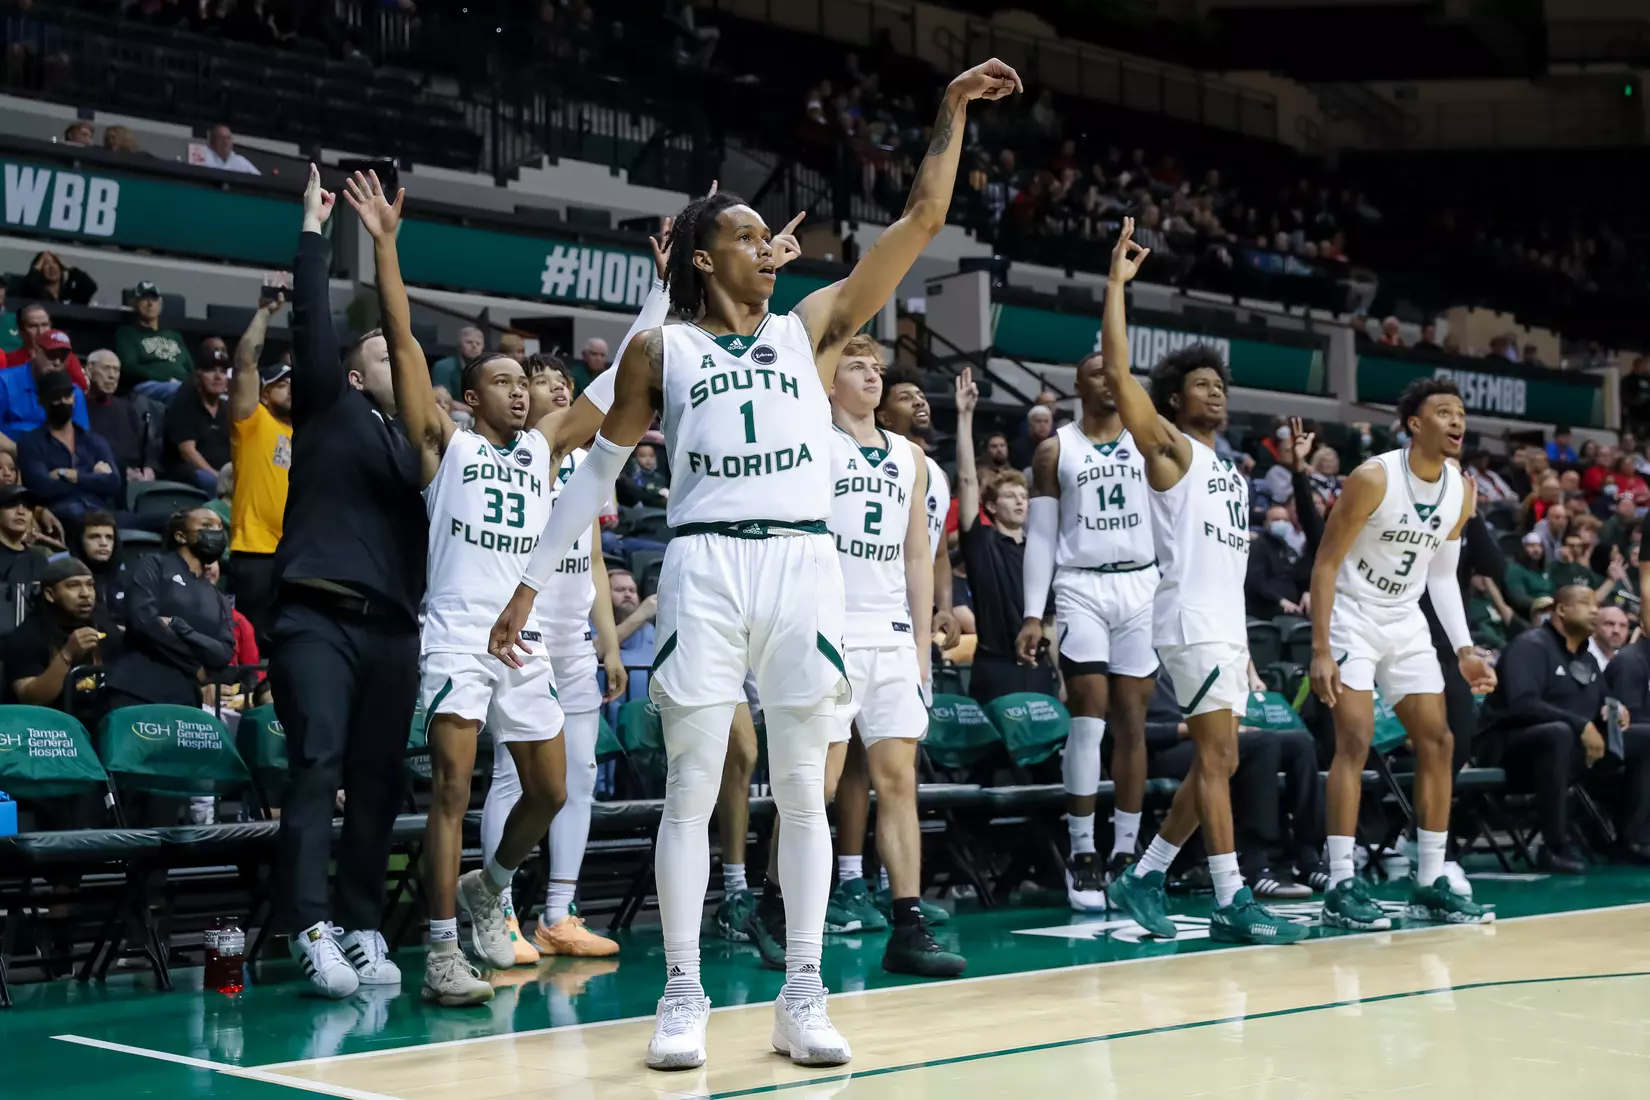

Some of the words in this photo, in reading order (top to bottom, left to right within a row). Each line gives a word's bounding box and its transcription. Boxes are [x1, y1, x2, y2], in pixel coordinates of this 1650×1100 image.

[4, 163, 120, 237] WBB
[690, 369, 799, 409] SOUTH
[739, 400, 757, 444] 1
[688, 443, 813, 478] FLORIDA
[463, 463, 541, 497] SOUTH
[1077, 464, 1142, 488] SOUTH
[834, 477, 906, 508] SOUTH
[1096, 483, 1125, 511] 14
[483, 487, 525, 528] 33
[864, 501, 882, 536] 2
[1076, 513, 1142, 531] FLORID
[1380, 530, 1440, 552] SOUTH
[1394, 550, 1417, 577] 3
[26, 727, 68, 740] Tampa
[137, 721, 171, 737] TGH
[175, 719, 213, 733] Tampa
[177, 729, 219, 740] General
[0, 733, 21, 746] GH
[27, 737, 74, 748] General
[177, 737, 222, 750] Hospital
[28, 746, 78, 758] Hospital
